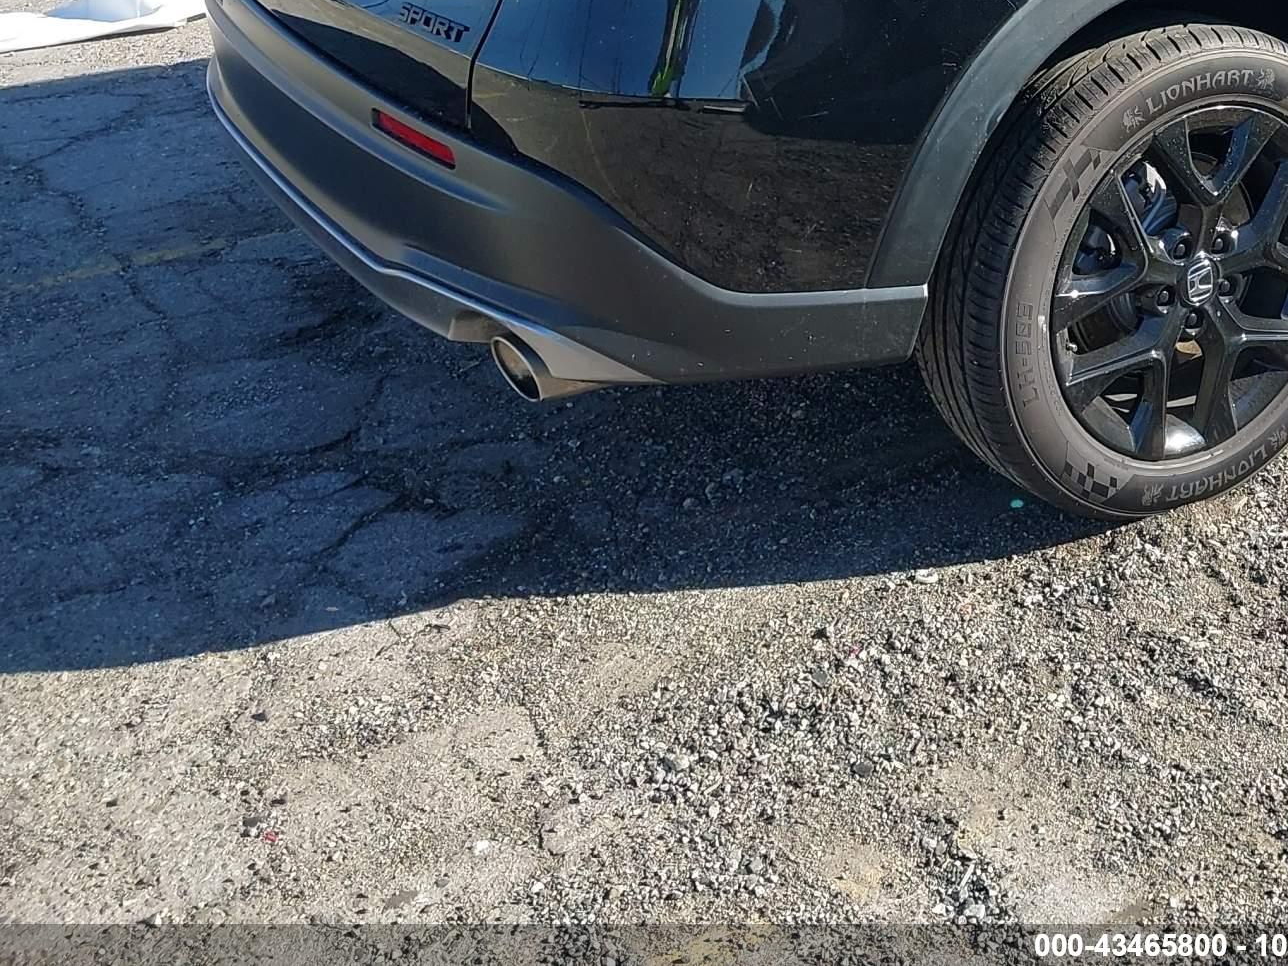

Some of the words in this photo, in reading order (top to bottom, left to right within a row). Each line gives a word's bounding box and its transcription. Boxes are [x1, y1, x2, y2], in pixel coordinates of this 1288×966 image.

[399, 1, 471, 43] SPORT
[1145, 68, 1254, 115] LIONHART
[1165, 444, 1268, 502] LIONHART
